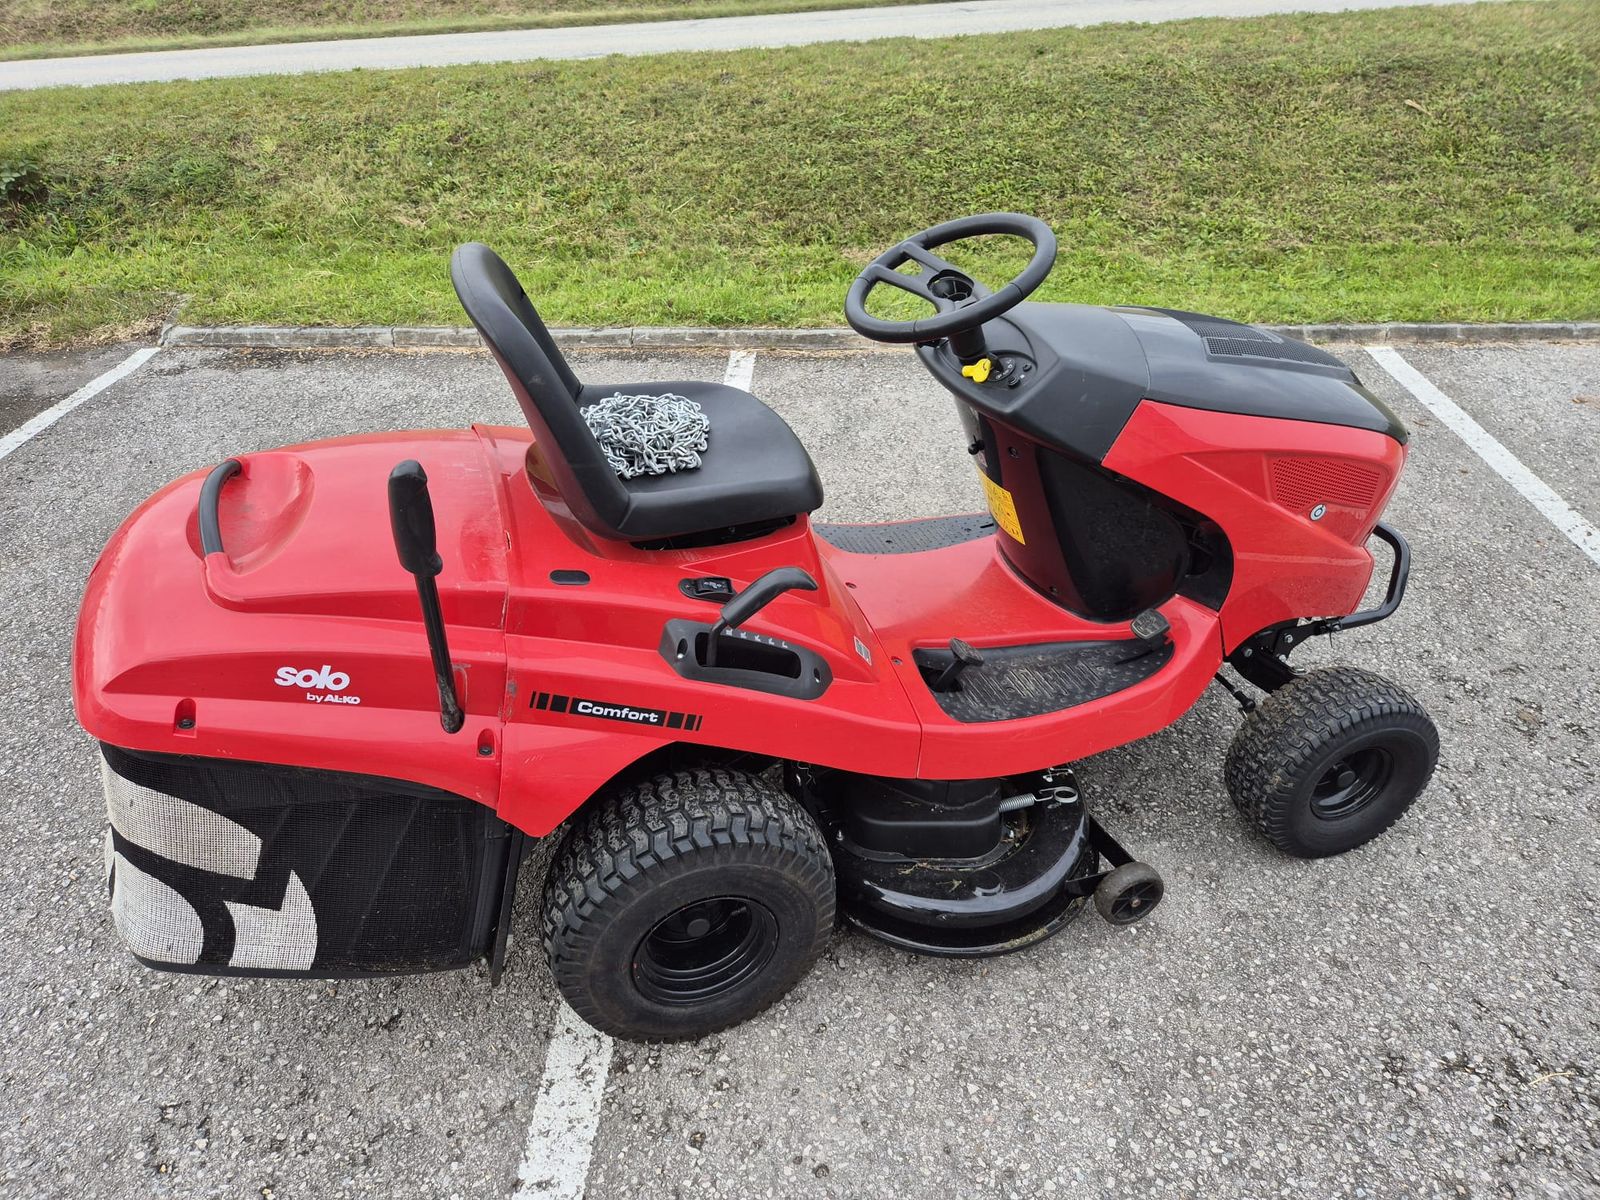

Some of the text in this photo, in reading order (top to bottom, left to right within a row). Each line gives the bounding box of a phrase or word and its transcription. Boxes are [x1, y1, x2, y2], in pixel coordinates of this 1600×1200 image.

[274, 665, 350, 691] solo
[306, 692, 361, 705] by AL-KO
[577, 701, 659, 723] Comfort
